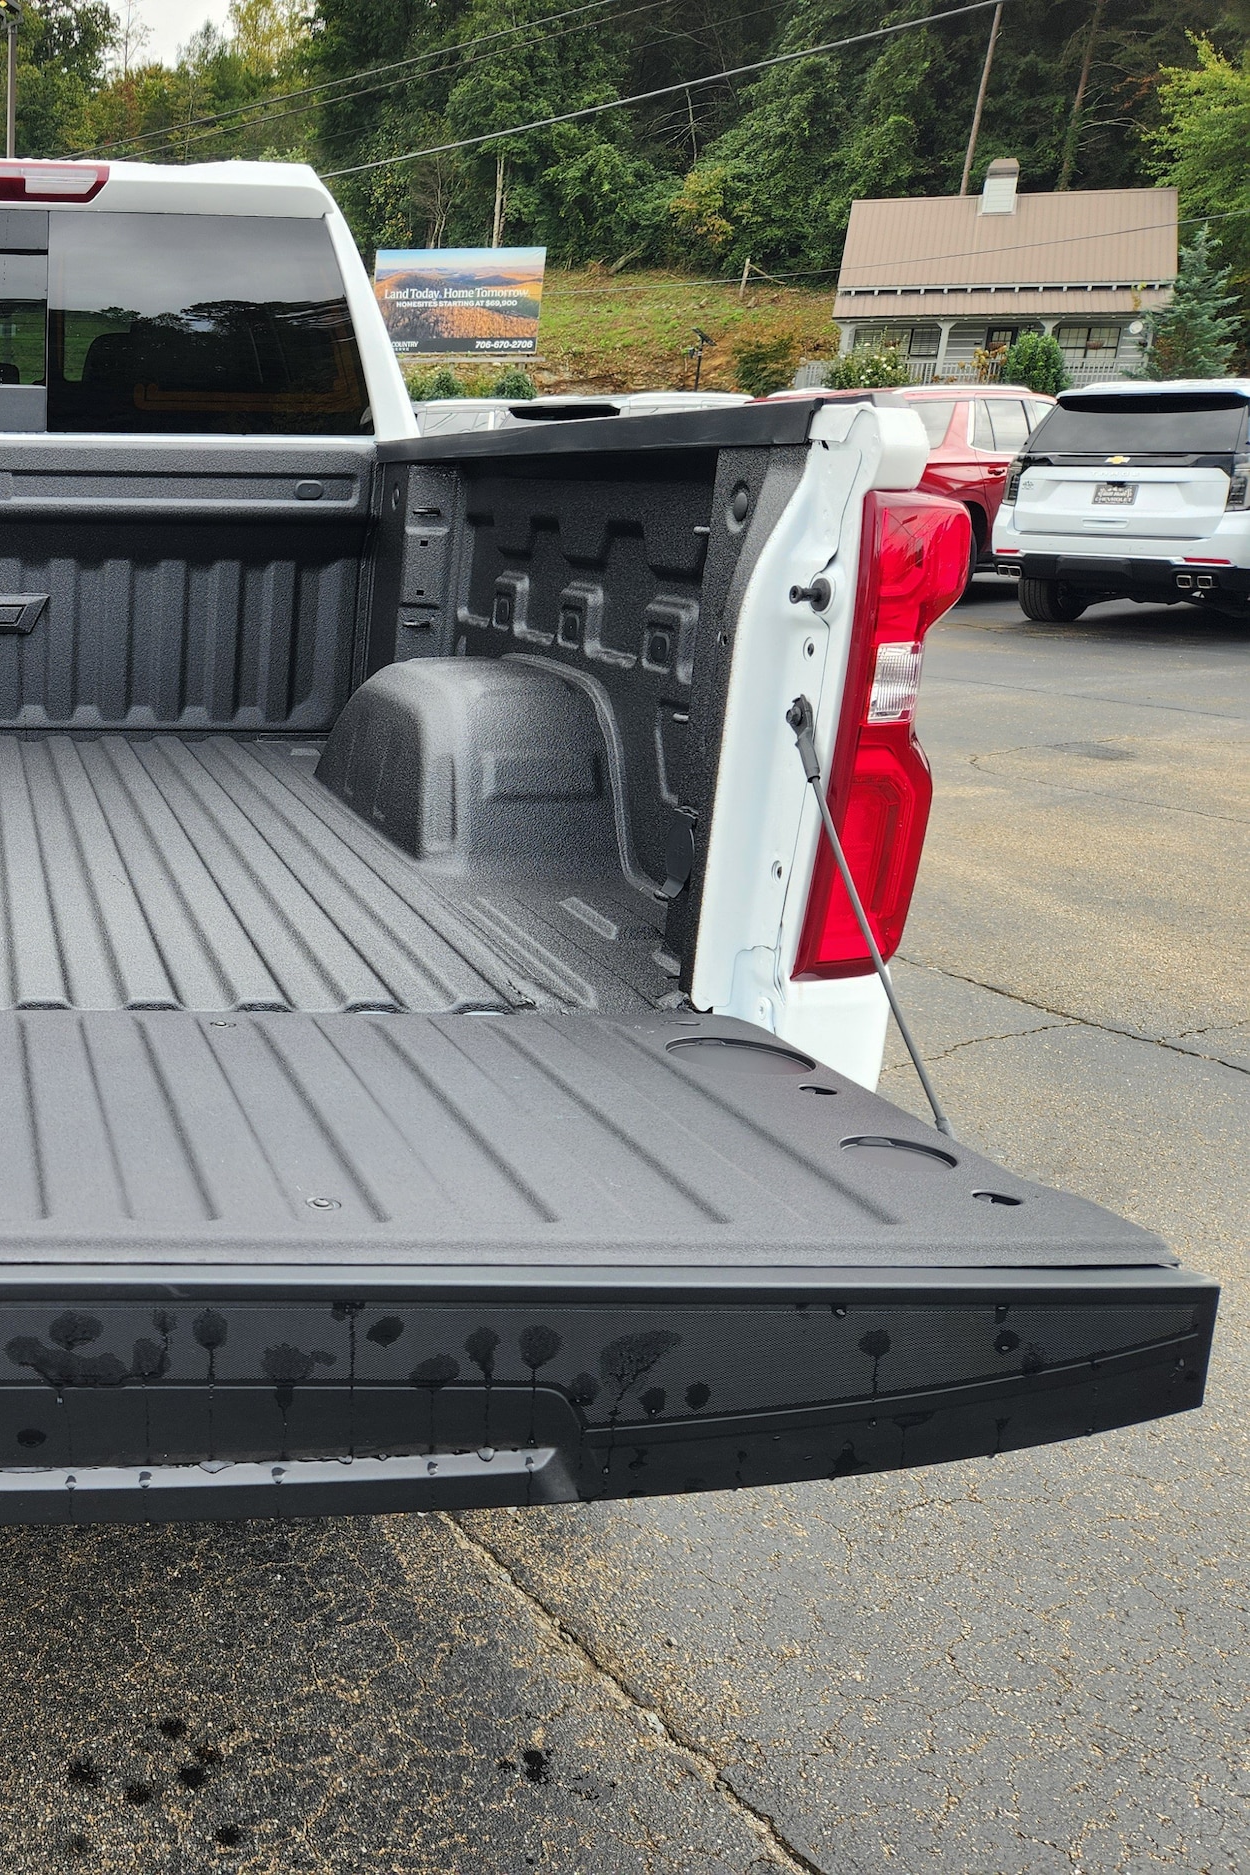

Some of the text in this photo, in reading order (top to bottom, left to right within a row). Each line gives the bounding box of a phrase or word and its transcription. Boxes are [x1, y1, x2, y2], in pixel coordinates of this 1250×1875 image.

[384, 289, 408, 299] Land
[444, 288, 474, 299] Home
[475, 288, 530, 298] Tomorrow.
[485, 299, 518, 307] $69,900
[475, 341, 533, 349] 706-670-2706
